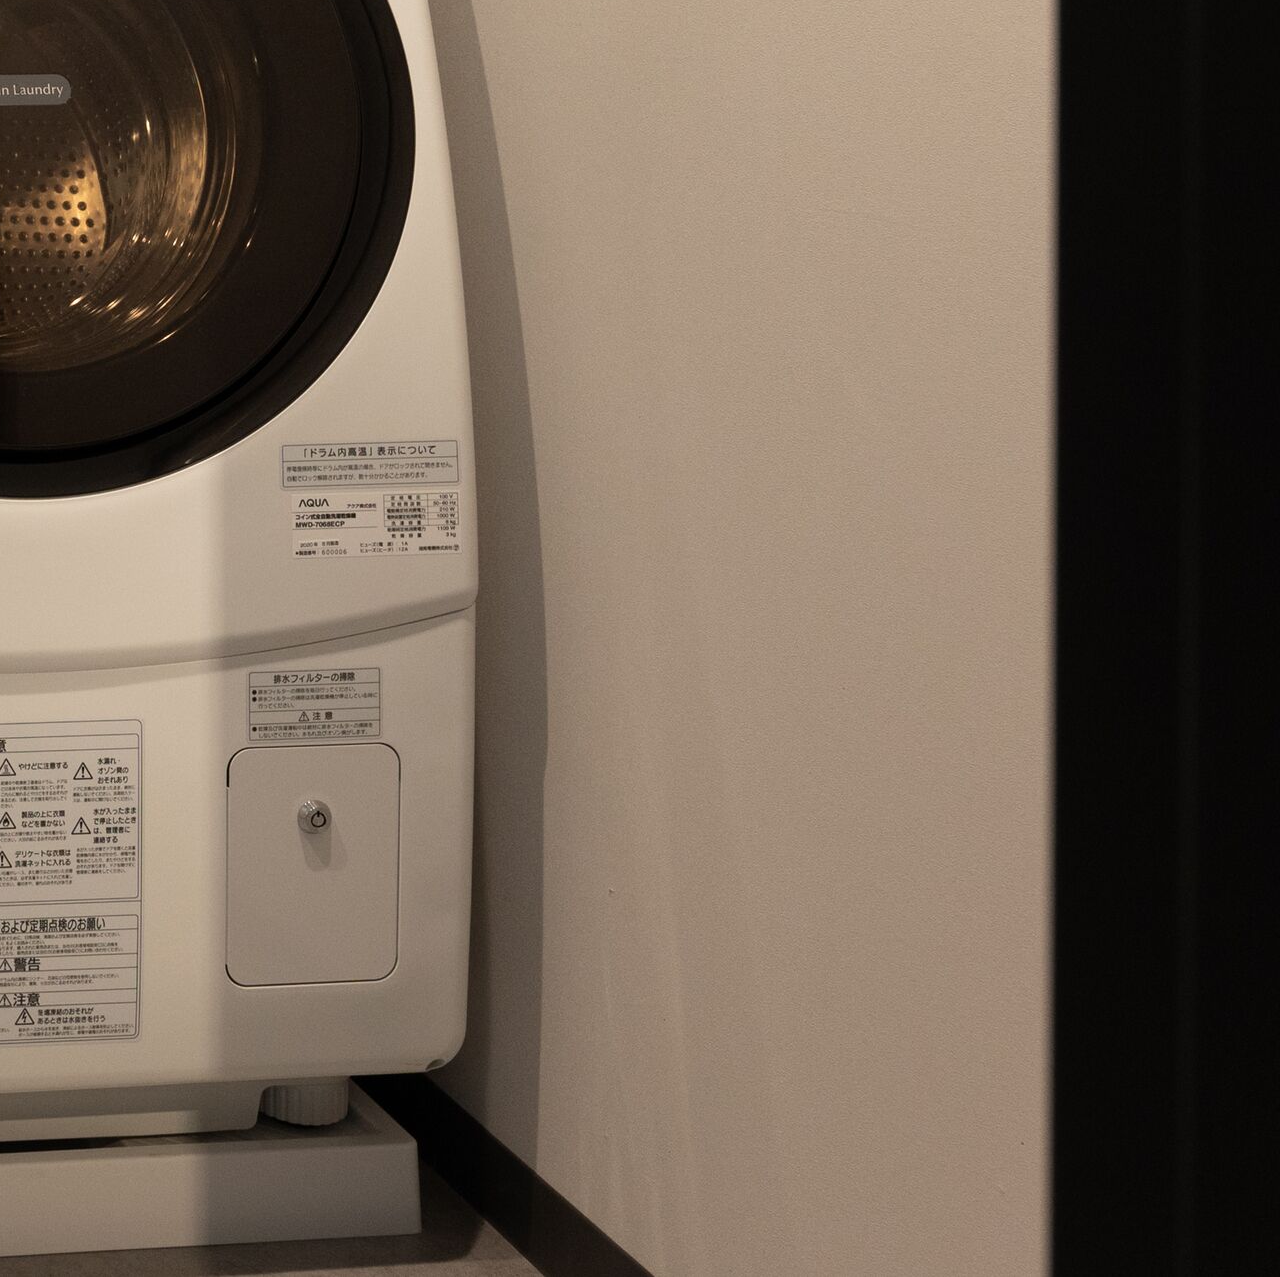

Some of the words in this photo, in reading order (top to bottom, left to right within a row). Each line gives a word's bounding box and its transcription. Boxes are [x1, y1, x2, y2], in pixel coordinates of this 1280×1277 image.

[13, 84, 63, 97] Laundry
[304, 446, 436, 458] 「ドラム内高温」表示について
[299, 499, 329, 507] AQUA
[274, 672, 355, 684] 排水フィルターの掃除
[14, 958, 40, 971] 警告
[14, 993, 40, 1006] 注意
